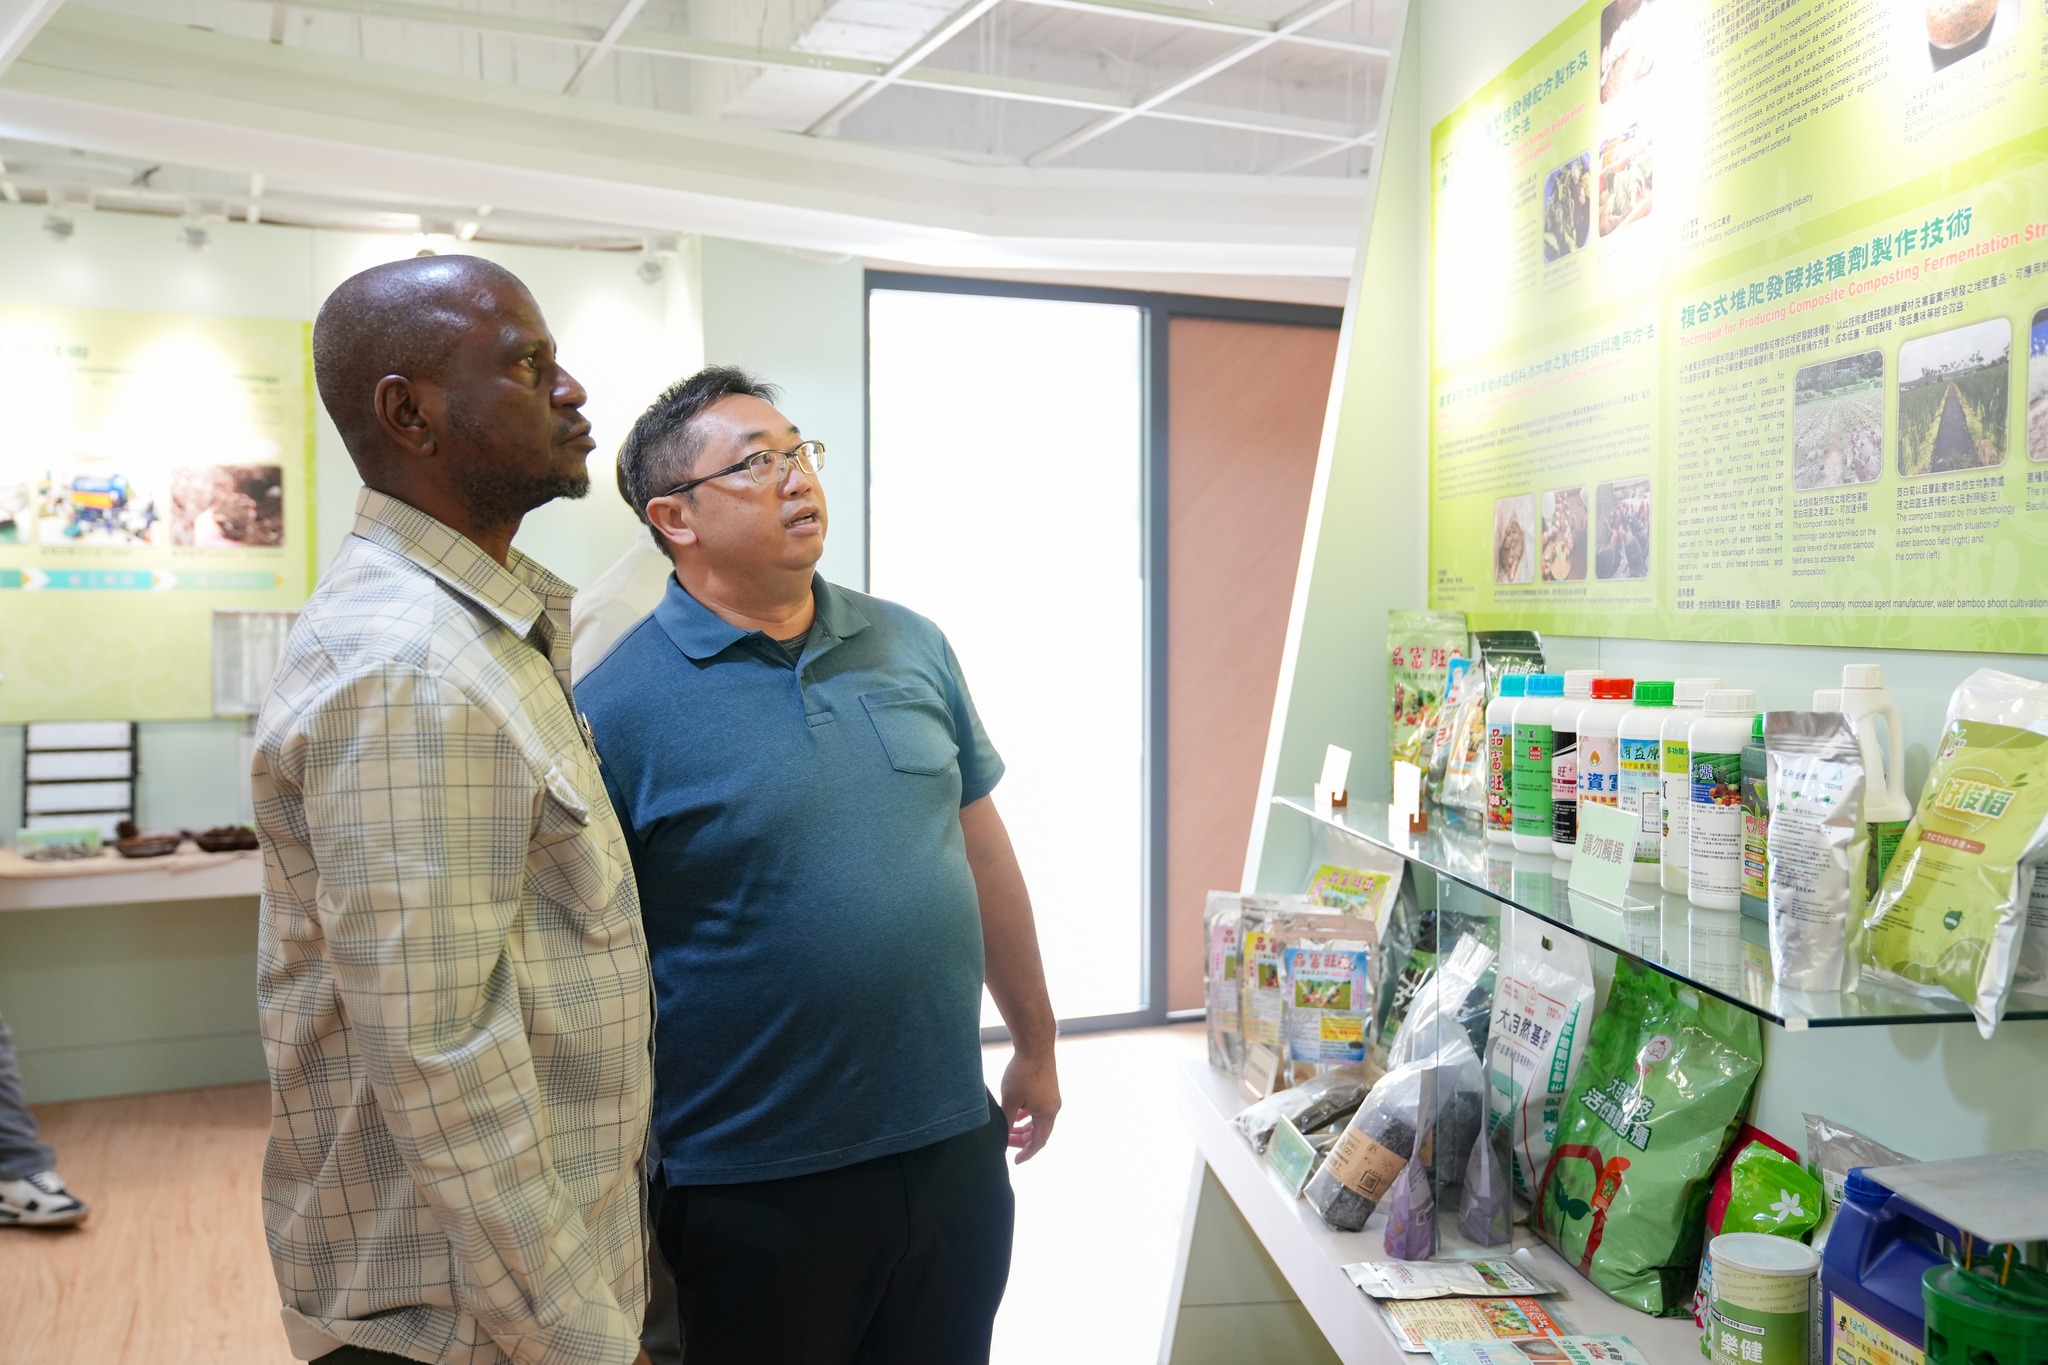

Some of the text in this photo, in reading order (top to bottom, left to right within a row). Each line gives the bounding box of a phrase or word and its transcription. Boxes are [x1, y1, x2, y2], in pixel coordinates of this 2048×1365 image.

[1681, 205, 1972, 329] 複合式堆肥發酵接種劑製作技術
[1680, 323, 1722, 351] Technique
[1725, 319, 1736, 334] for
[1739, 303, 1786, 333] Producing
[1789, 284, 1844, 318] Composite
[1848, 260, 1919, 300] Composting
[1924, 228, 2018, 272] Fermentation
[1896, 503, 2015, 522] The compost treated by this technology
[1802, 519, 1822, 529] compost
[1823, 517, 1837, 525] made
[1838, 517, 1844, 526] by
[1845, 516, 1854, 524] this
[1896, 519, 2000, 536] is applied to the growth situation of
[1792, 532, 1817, 542] technology
[1828, 530, 1834, 538] be
[1836, 529, 1858, 539] sprinkled
[1867, 527, 1876, 535] the
[1896, 539, 1910, 547] water
[1912, 537, 1935, 546] bamboo
[1937, 536, 1949, 545] field
[1971, 534, 1983, 543] and
[1792, 544, 1805, 552] waste
[1806, 543, 1822, 551] leaves
[1838, 541, 1851, 549] water
[1853, 540, 1874, 548] bamboo
[1820, 554, 1844, 562] accelerate
[1895, 552, 1904, 560] the
[1905, 551, 1924, 560] control
[1789, 599, 1819, 610] Composting
[1847, 598, 1873, 607] microbial
[1874, 598, 1891, 610] agent
[1937, 597, 1954, 607] water
[1957, 597, 1985, 607] bamboo
[1987, 597, 2007, 607] shoot
[1392, 646, 1447, 670] 品富旺
[1582, 832, 1625, 864] 請勿觸摸
[1721, 1331, 1763, 1363] 樂健
